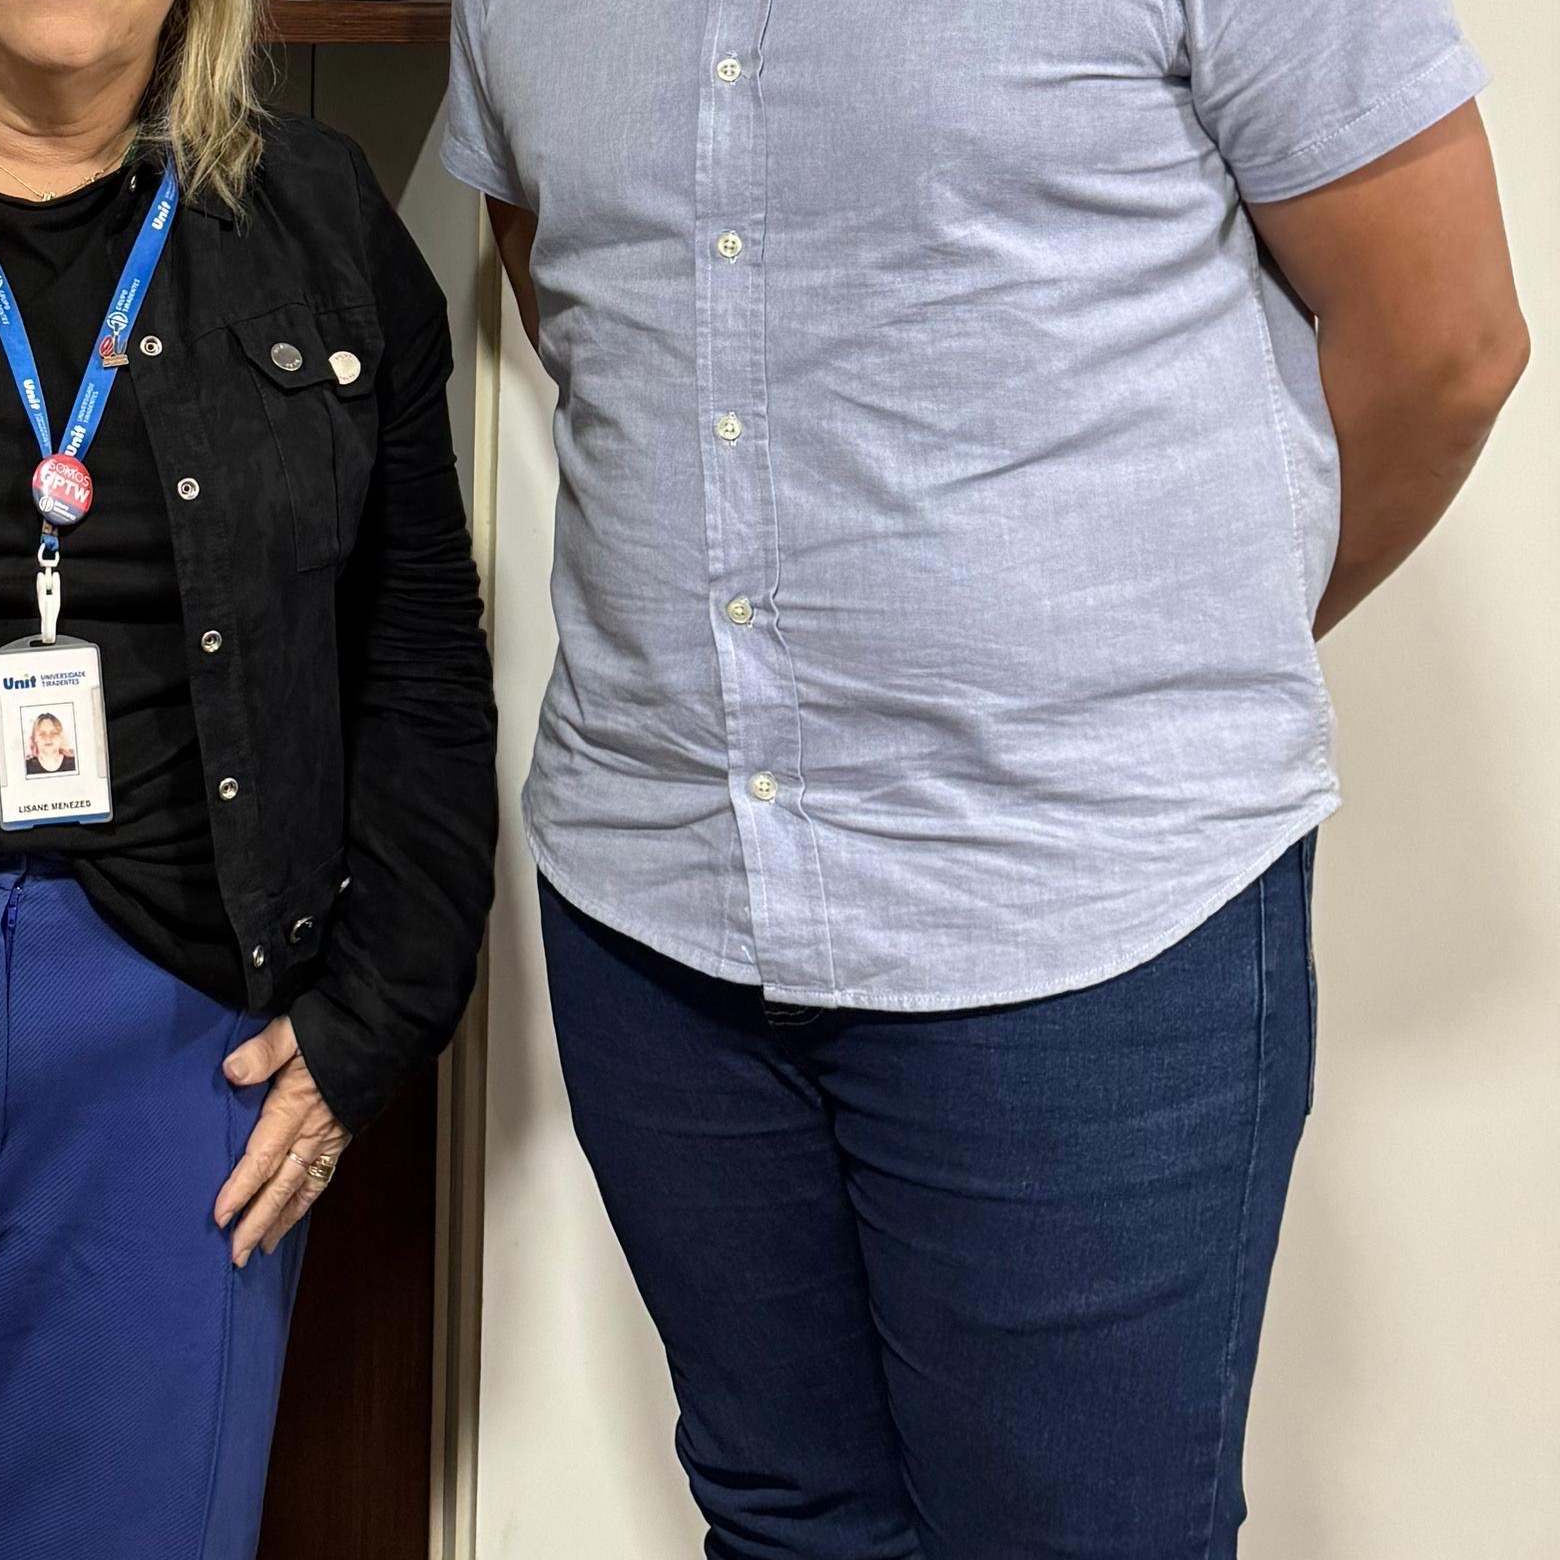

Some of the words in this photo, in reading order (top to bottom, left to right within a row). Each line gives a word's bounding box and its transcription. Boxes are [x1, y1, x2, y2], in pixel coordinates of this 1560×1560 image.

[23, 378, 41, 410] Unit
[65, 424, 87, 457] Unit
[48, 459, 90, 487] SOMOS
[3, 674, 37, 690] Unit
[41, 671, 86, 681] UNIVERSIDADE
[42, 678, 80, 688] TIRADENTES
[19, 802, 50, 814] LISANE
